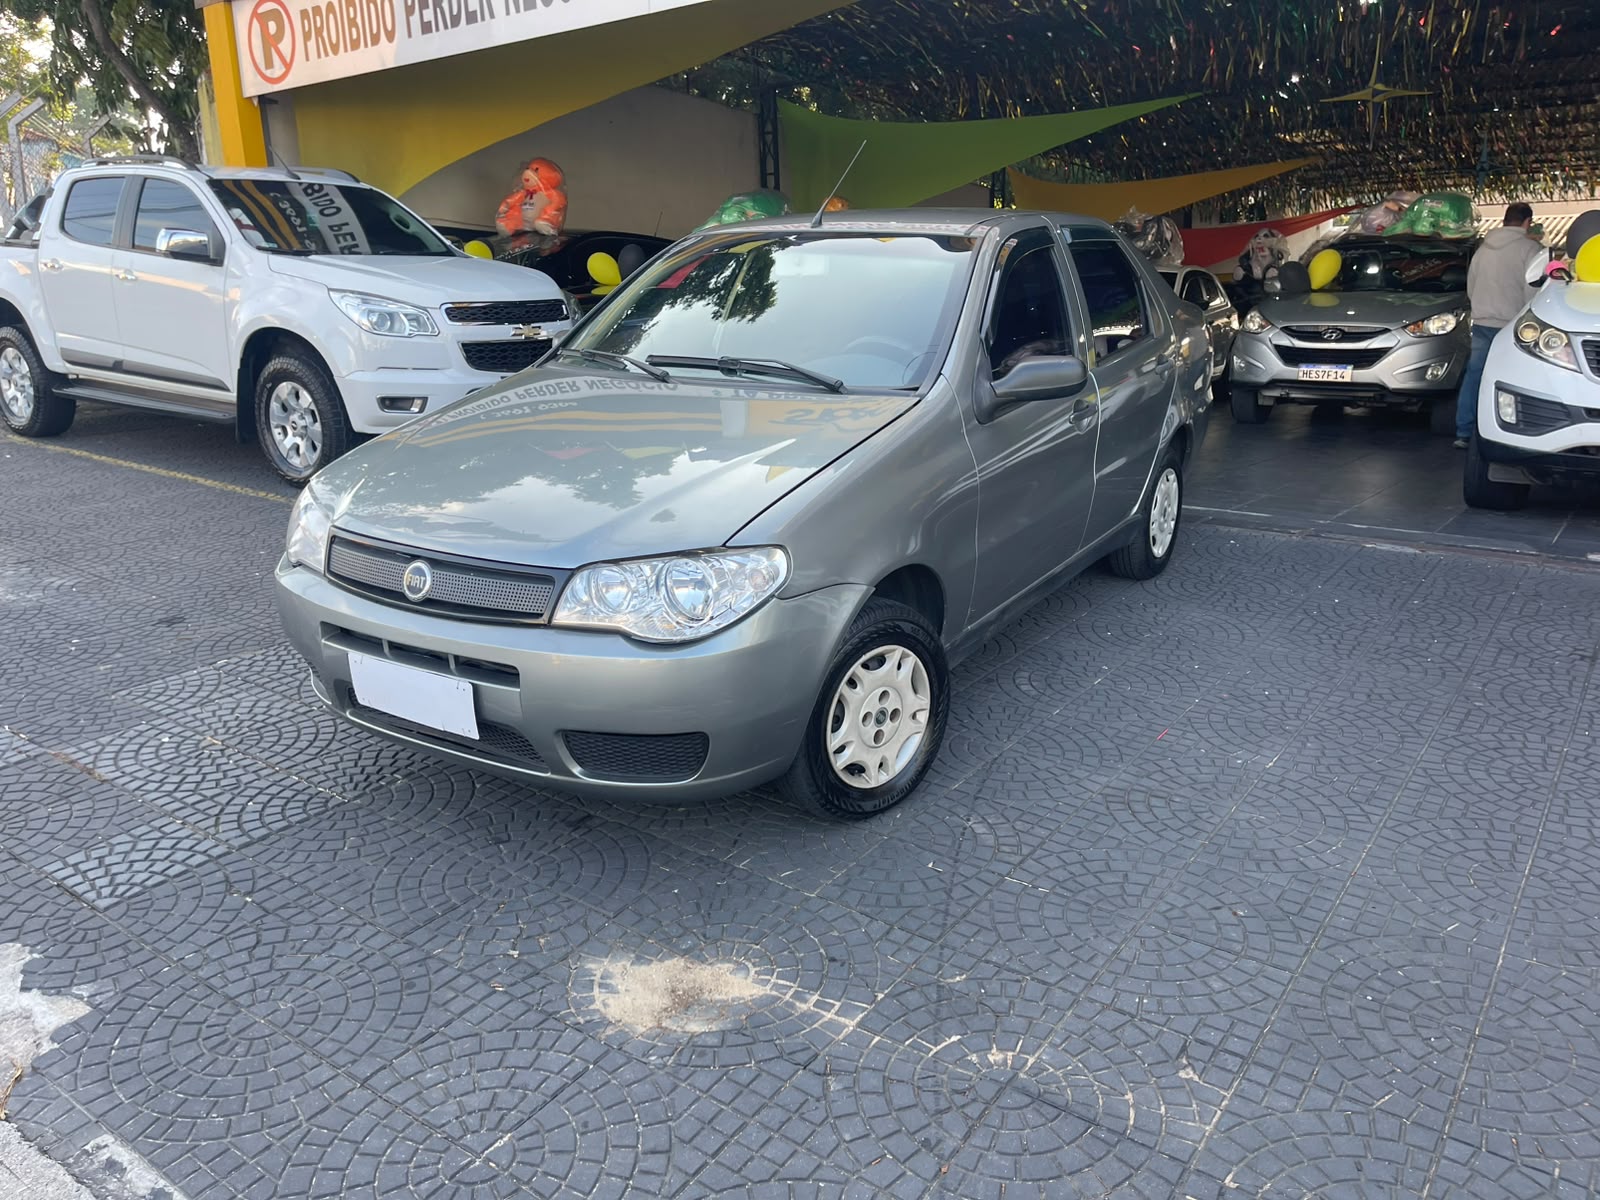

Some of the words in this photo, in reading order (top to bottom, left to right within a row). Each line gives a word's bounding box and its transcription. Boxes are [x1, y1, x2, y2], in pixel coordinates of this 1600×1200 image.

[300, 0, 396, 62] PROIBIDO
[1302, 369, 1345, 380] HES7F14
[406, 573, 426, 589] FIAT
